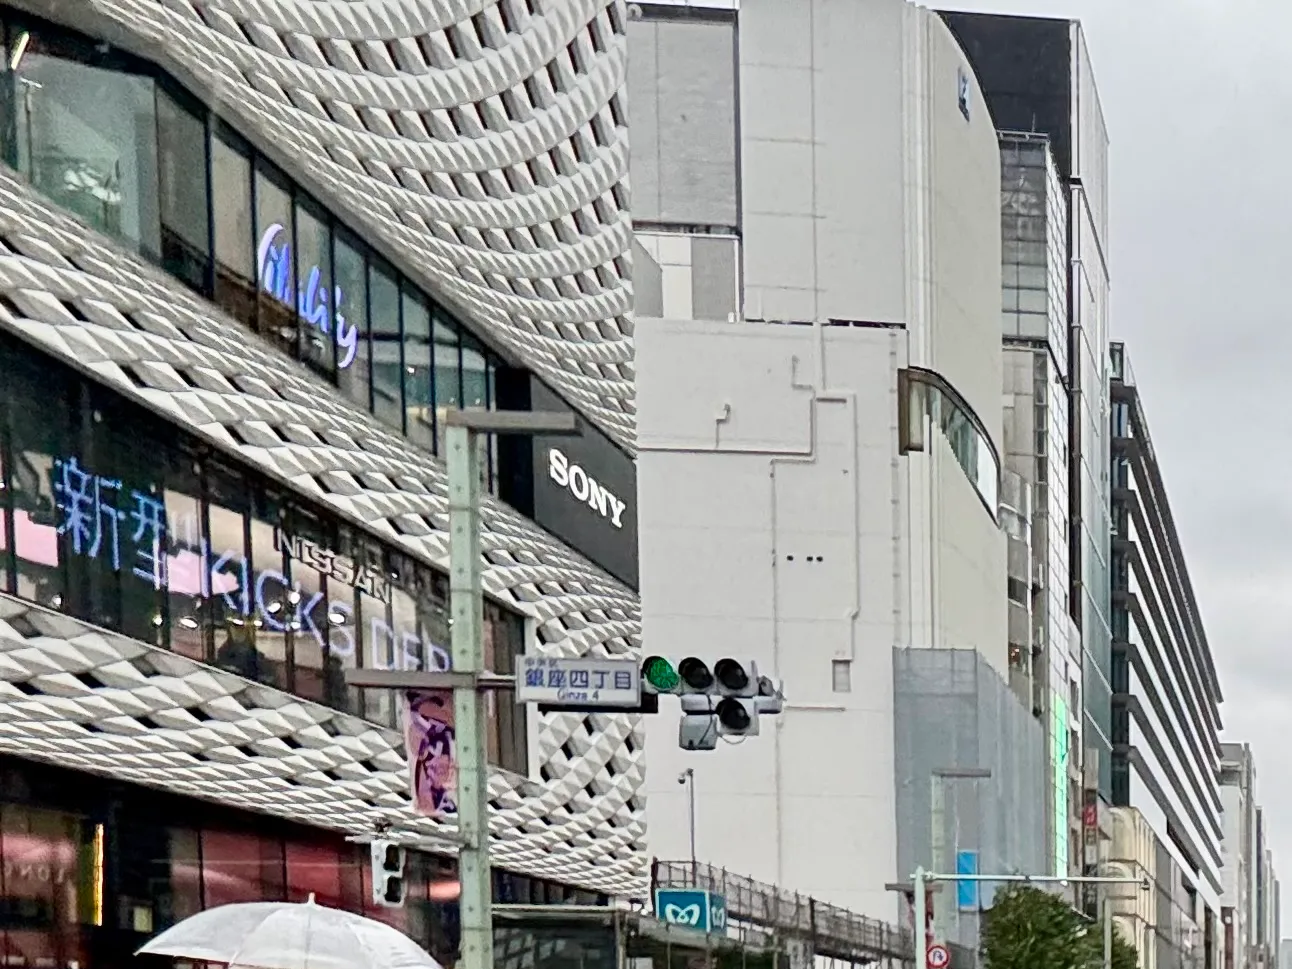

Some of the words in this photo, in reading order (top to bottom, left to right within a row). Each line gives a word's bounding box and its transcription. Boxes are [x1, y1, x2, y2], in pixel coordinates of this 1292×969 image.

[549, 448, 626, 529] SONY
[278, 527, 391, 603] NISSAN
[525, 668, 631, 689] 銀座四丁目
[557, 687, 588, 700] Ginza
[592, 690, 600, 700] 4
